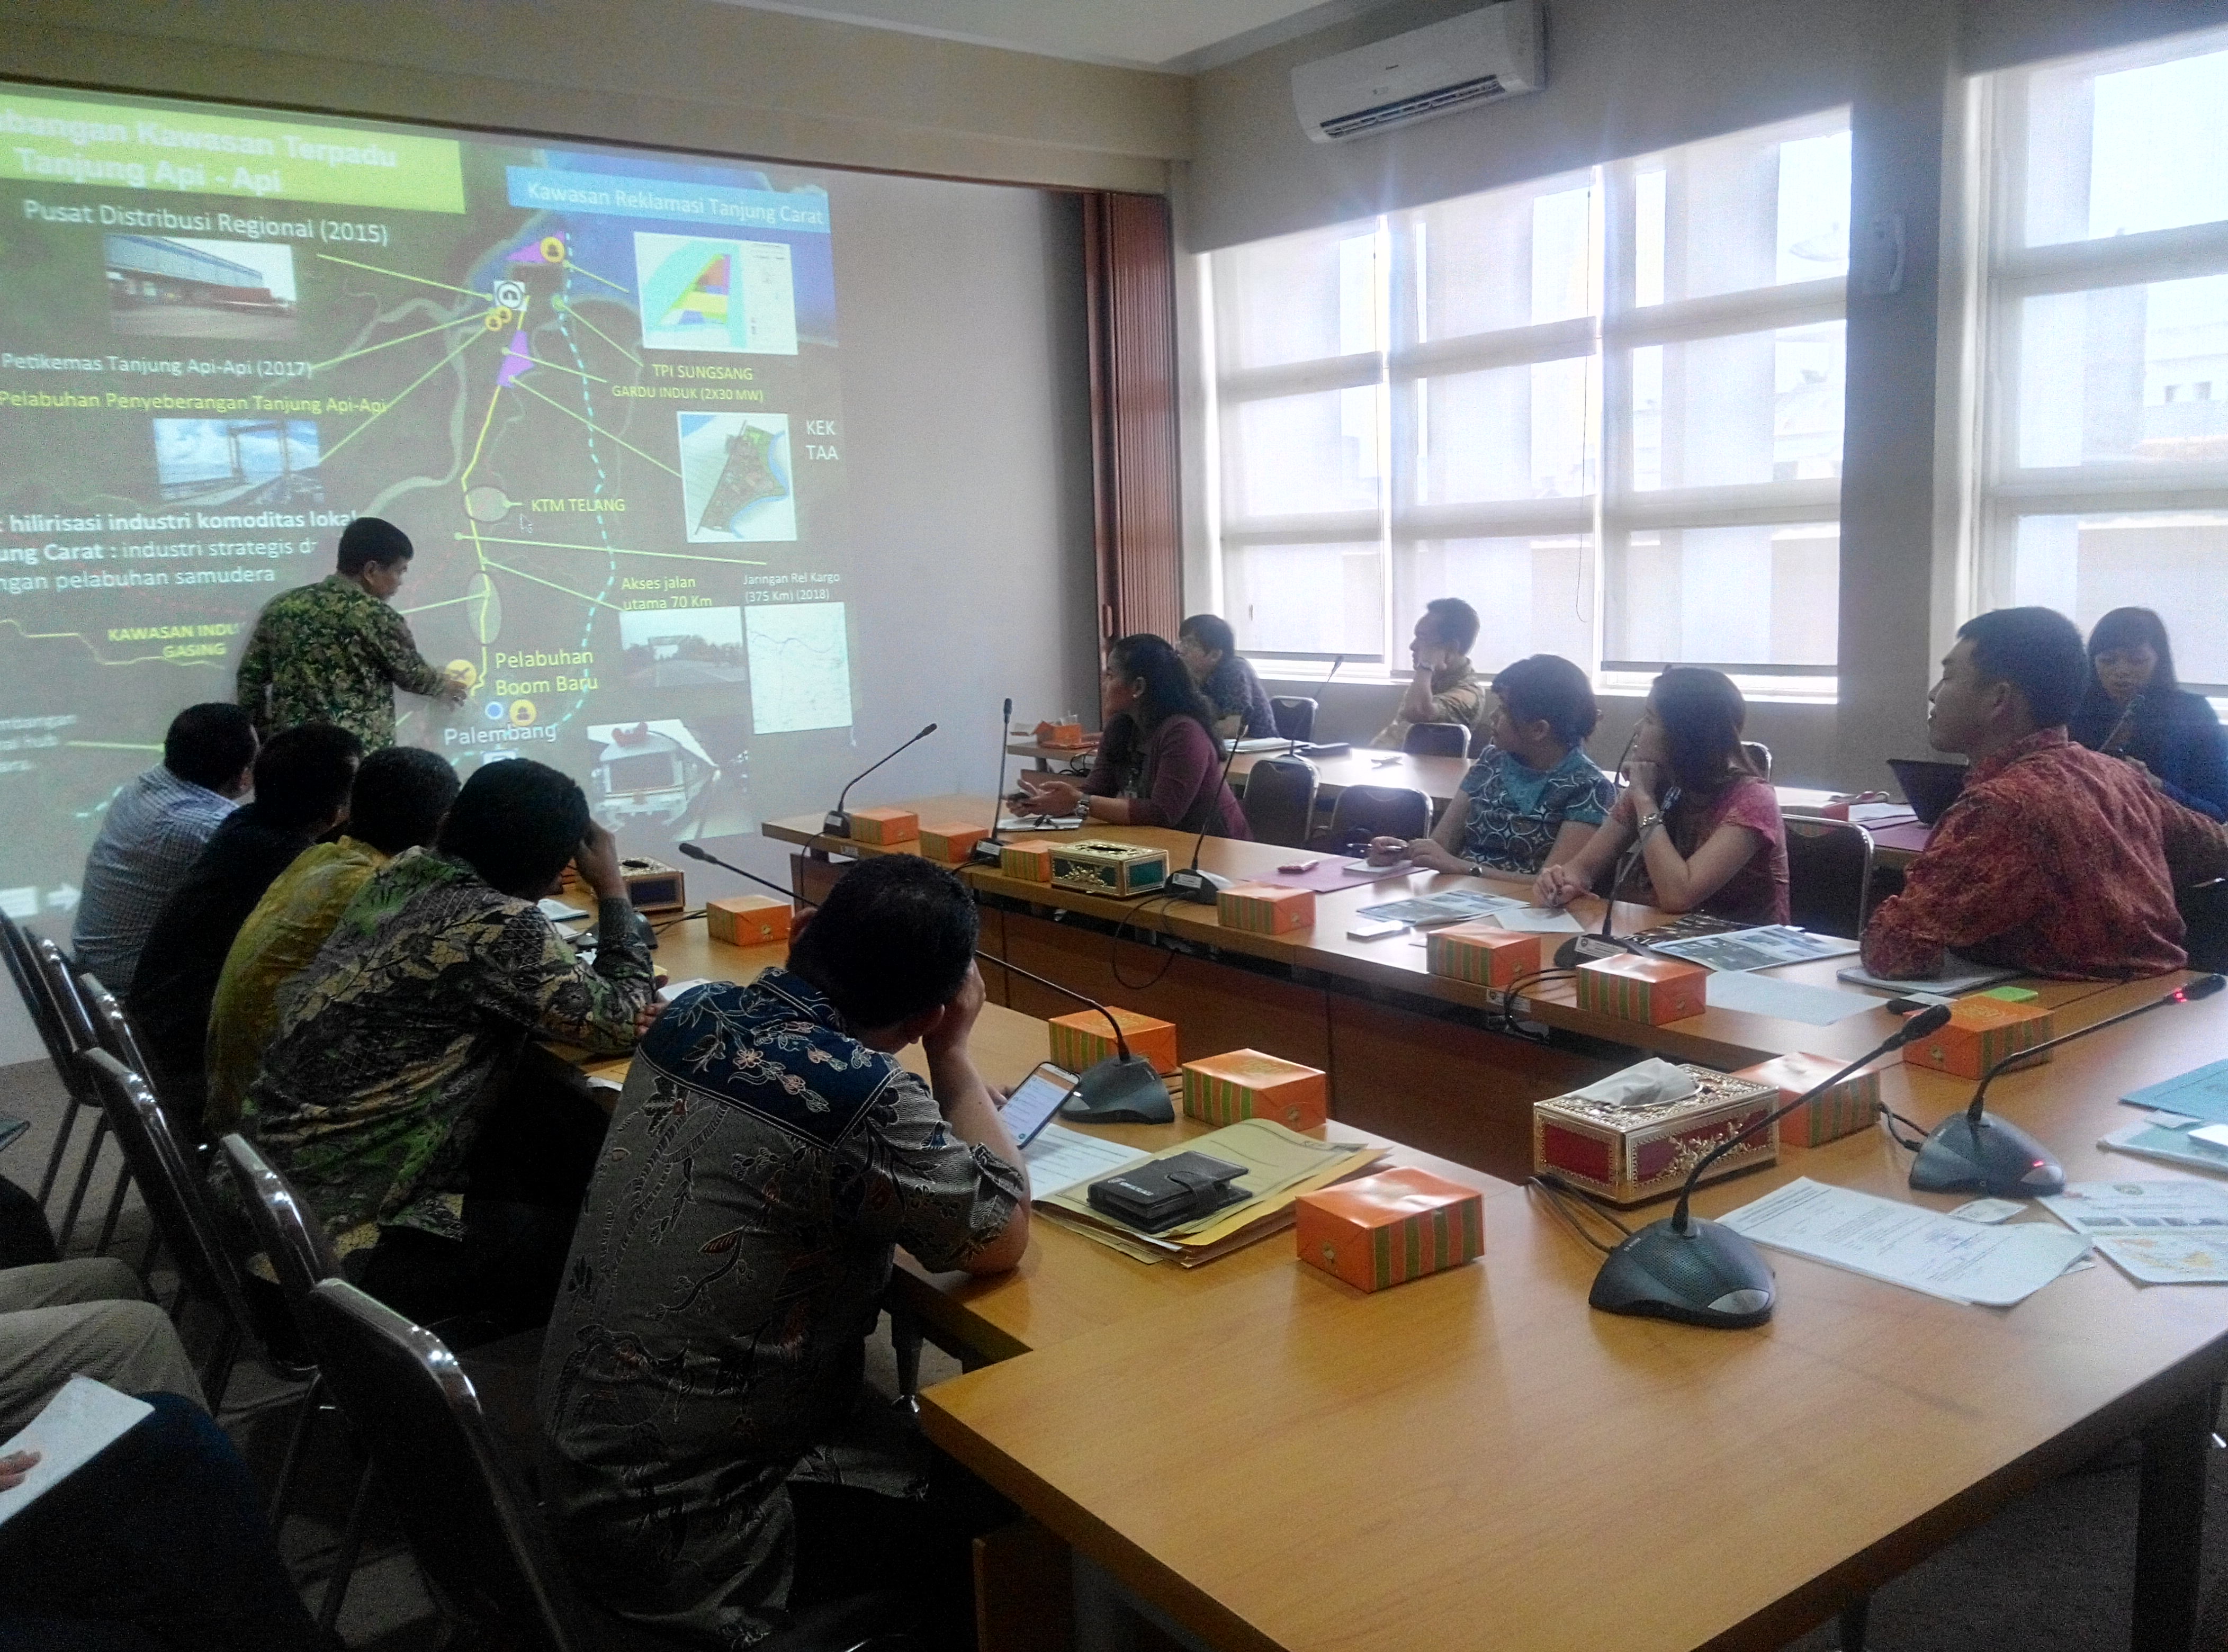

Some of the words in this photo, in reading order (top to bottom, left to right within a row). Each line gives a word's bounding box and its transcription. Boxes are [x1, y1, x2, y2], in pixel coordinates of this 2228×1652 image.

[137, 121, 274, 155] Kawasan
[282, 135, 397, 168] Terpadu
[13, 147, 146, 188] Tanjung
[155, 160, 204, 191] Api
[232, 166, 282, 196] Api
[528, 184, 609, 205] Kawasan
[616, 190, 704, 213] Reklamasi
[708, 199, 776, 224] Tanjung
[780, 205, 824, 225] Carat
[23, 199, 95, 224] Pusat
[100, 203, 211, 230] Distribusi
[218, 213, 315, 238] Regional
[320, 218, 388, 247] (2015)
[2, 353, 103, 371] Petikemas
[106, 355, 183, 376] Tanjung
[187, 358, 251, 376] Api-Api
[257, 361, 312, 380] (2017)
[651, 364, 673, 377] TPI
[677, 365, 754, 381] SUNGSANG
[0, 390, 101, 407] Pelabuhan
[106, 392, 249, 414] Penyeberangan
[251, 396, 322, 415] Tanjung
[611, 384, 656, 398] GARDU
[659, 387, 698, 399] INDUK
[735, 389, 765, 405] MW)
[805, 419, 836, 436] KEK
[805, 444, 839, 460] TAA
[532, 498, 565, 513] KTM
[568, 498, 626, 512] TELANG
[9, 514, 102, 532] hilirisasi
[109, 513, 191, 531] industri
[196, 511, 306, 529] komoditas
[43, 543, 105, 560] Carat
[122, 540, 202, 558] industri
[209, 538, 293, 559] strategis
[56, 569, 168, 592] pelabuhan
[175, 565, 275, 585] samudera
[622, 577, 661, 590] Akses
[664, 575, 696, 591] jalan
[743, 574, 788, 587] Jaringan
[790, 572, 808, 583] Rel
[810, 572, 841, 585] Kargo
[623, 599, 668, 611] utama
[670, 596, 688, 608] 70
[690, 595, 713, 607] Km
[744, 590, 769, 605] (375
[771, 590, 794, 603] Km)
[796, 588, 830, 602] (2018)
[107, 627, 194, 642] KAWASAN
[163, 642, 227, 658] GASING
[496, 648, 594, 670] Pelabuhan
[496, 679, 551, 696] Boom
[556, 676, 599, 692] Baru
[444, 722, 557, 747] Palembang
